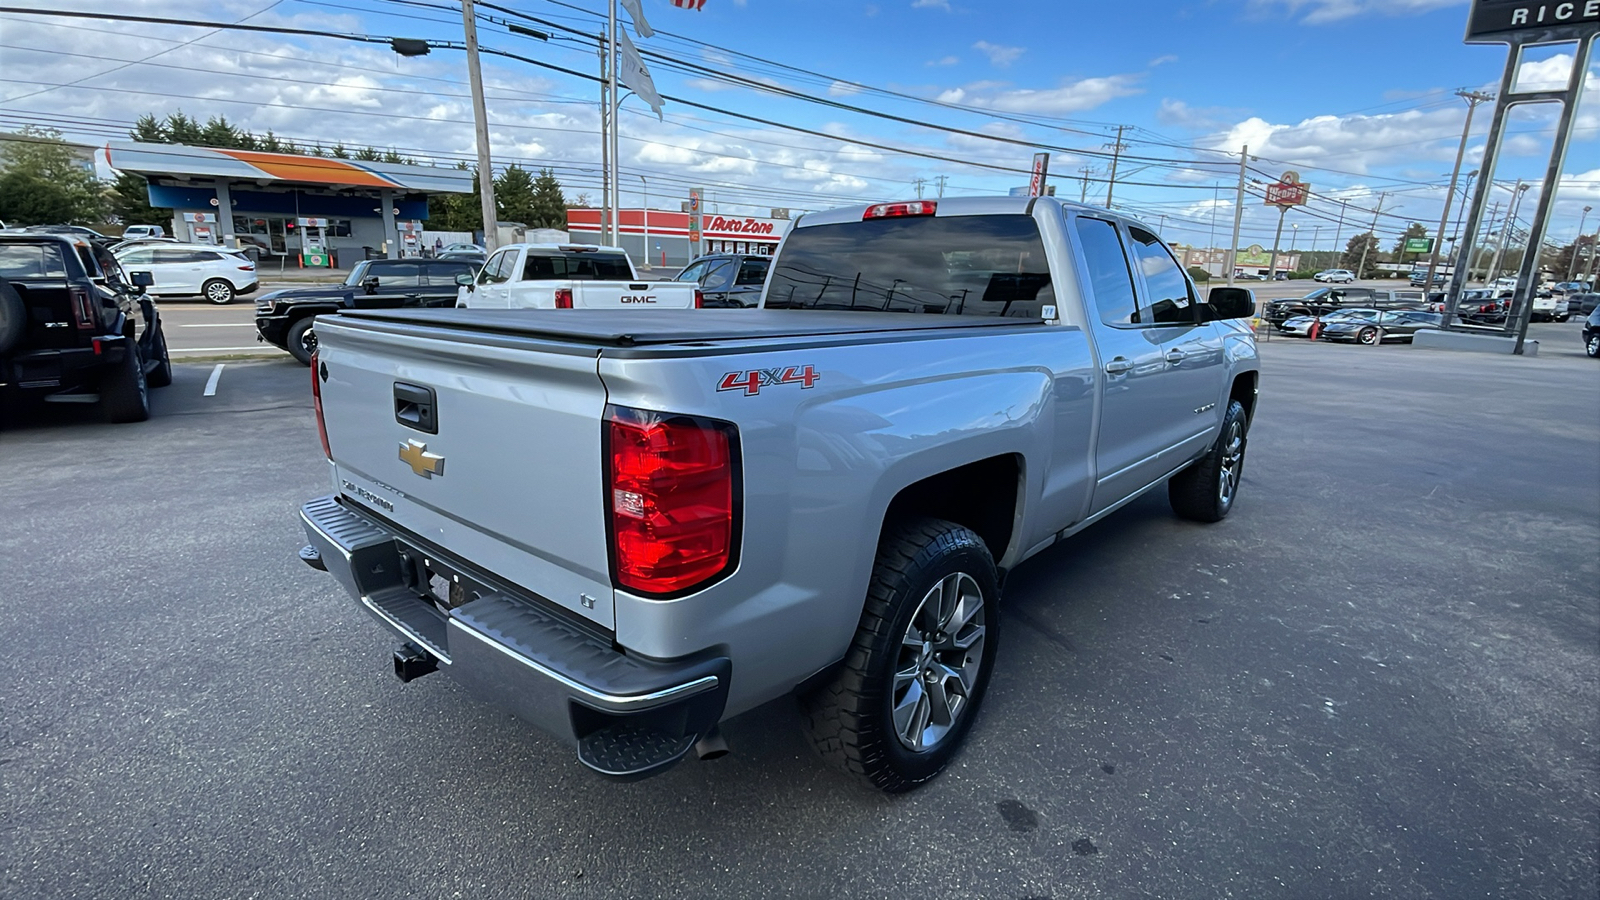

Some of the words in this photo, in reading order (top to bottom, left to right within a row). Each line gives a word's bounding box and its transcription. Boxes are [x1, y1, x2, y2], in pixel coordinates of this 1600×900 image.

[1511, 0, 1600, 25] RICE
[710, 216, 774, 234] AutoZone
[620, 295, 657, 304] GMC
[580, 592, 596, 610] LT
